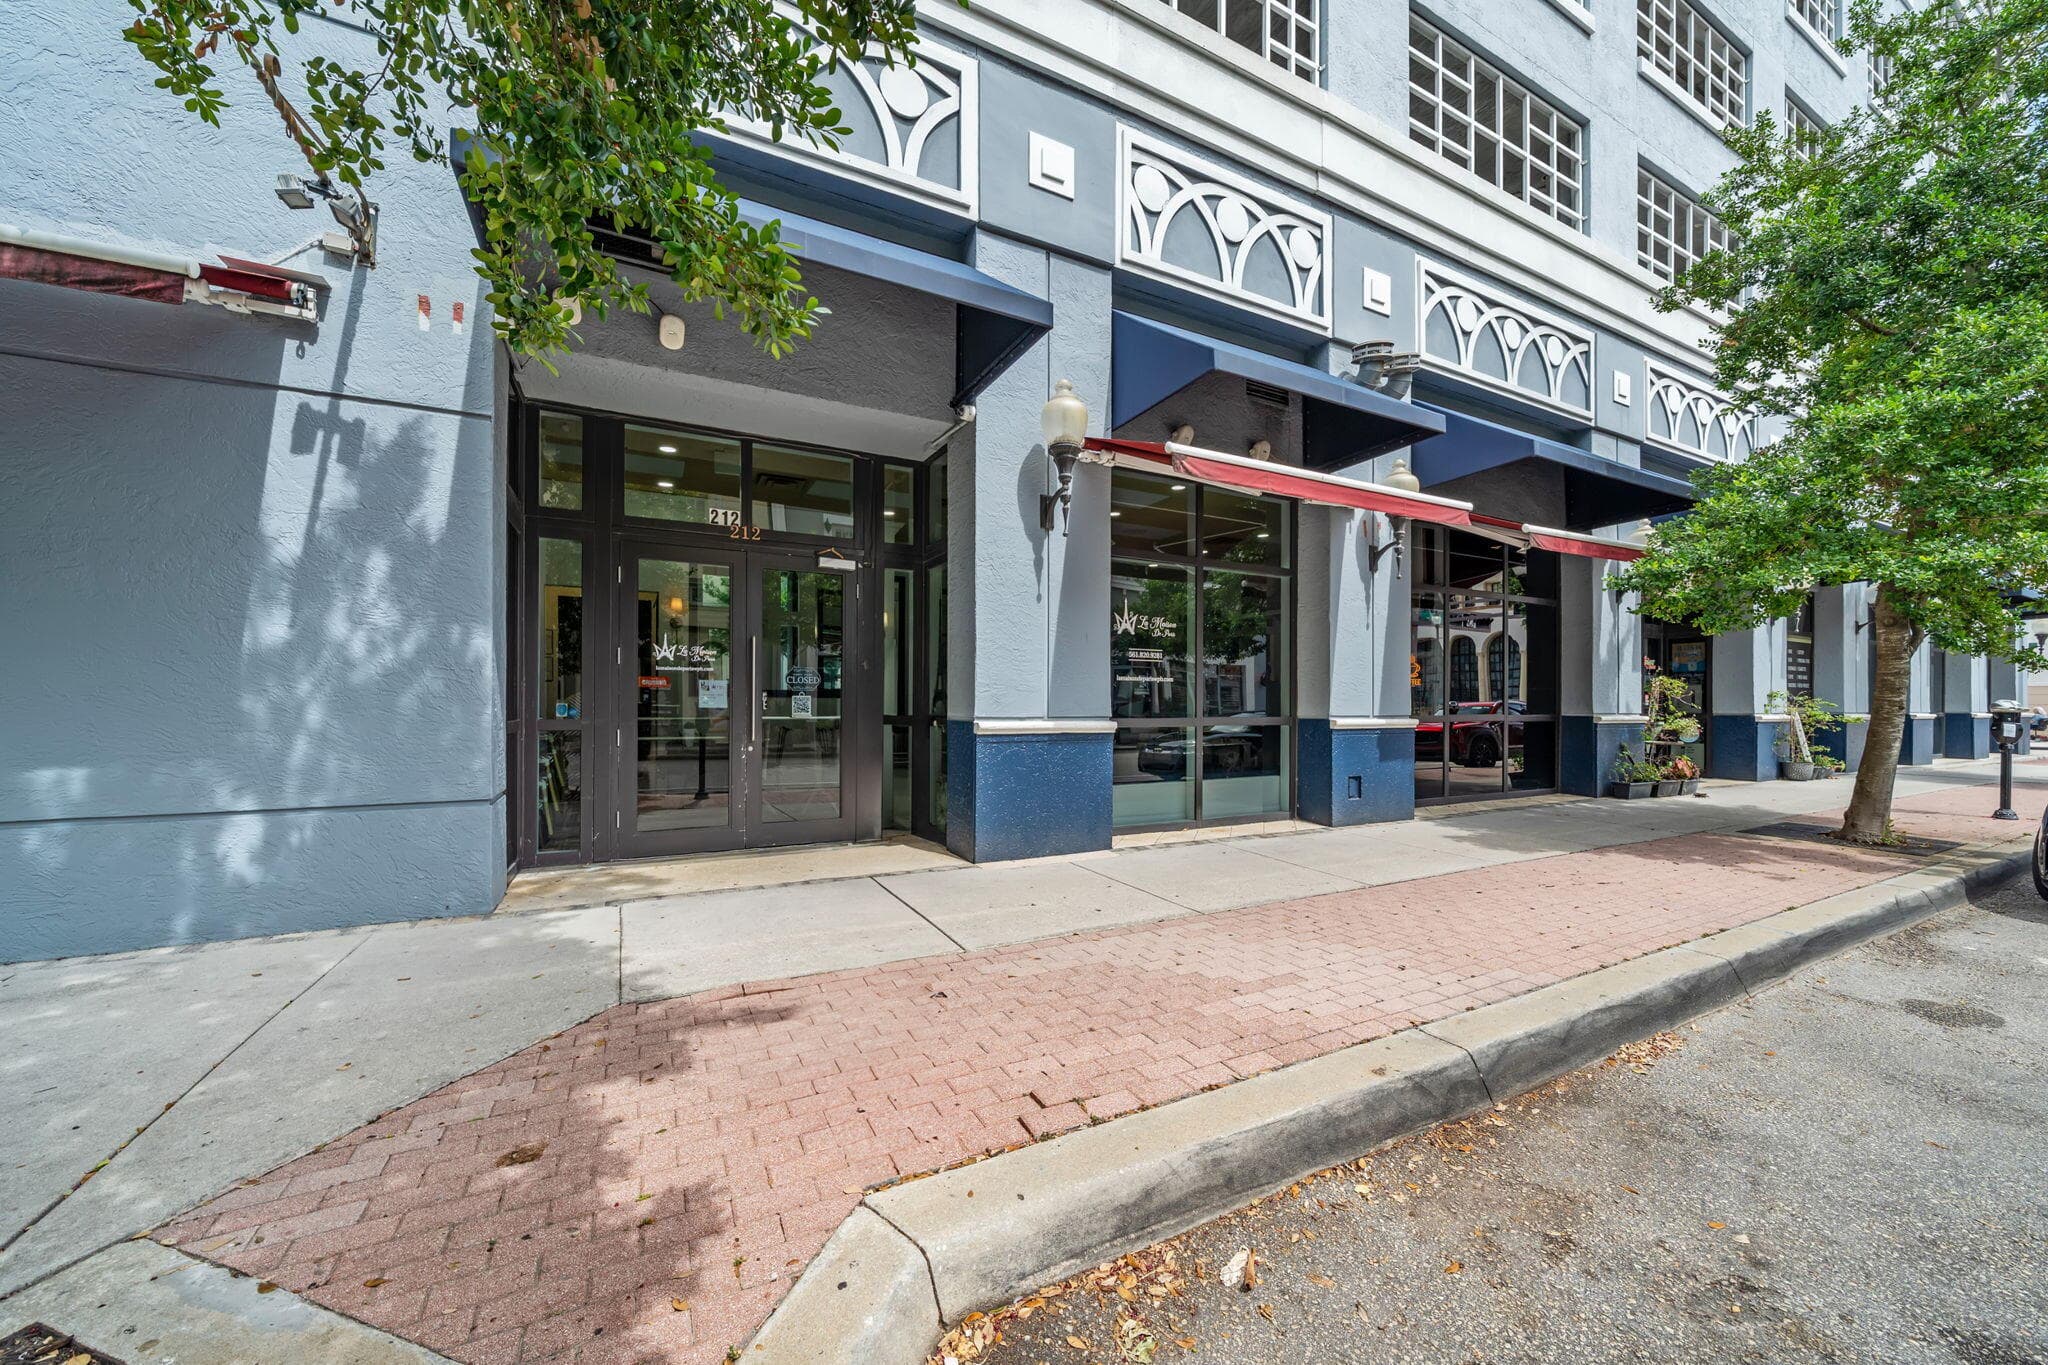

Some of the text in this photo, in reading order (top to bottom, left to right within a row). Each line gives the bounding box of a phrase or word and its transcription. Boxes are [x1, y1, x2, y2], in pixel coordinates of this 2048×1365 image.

[710, 509, 739, 526] 212
[730, 525, 761, 540] 212
[1137, 615, 1177, 629] La Maison
[677, 645, 688, 656] La
[786, 675, 820, 684] CLOSED
